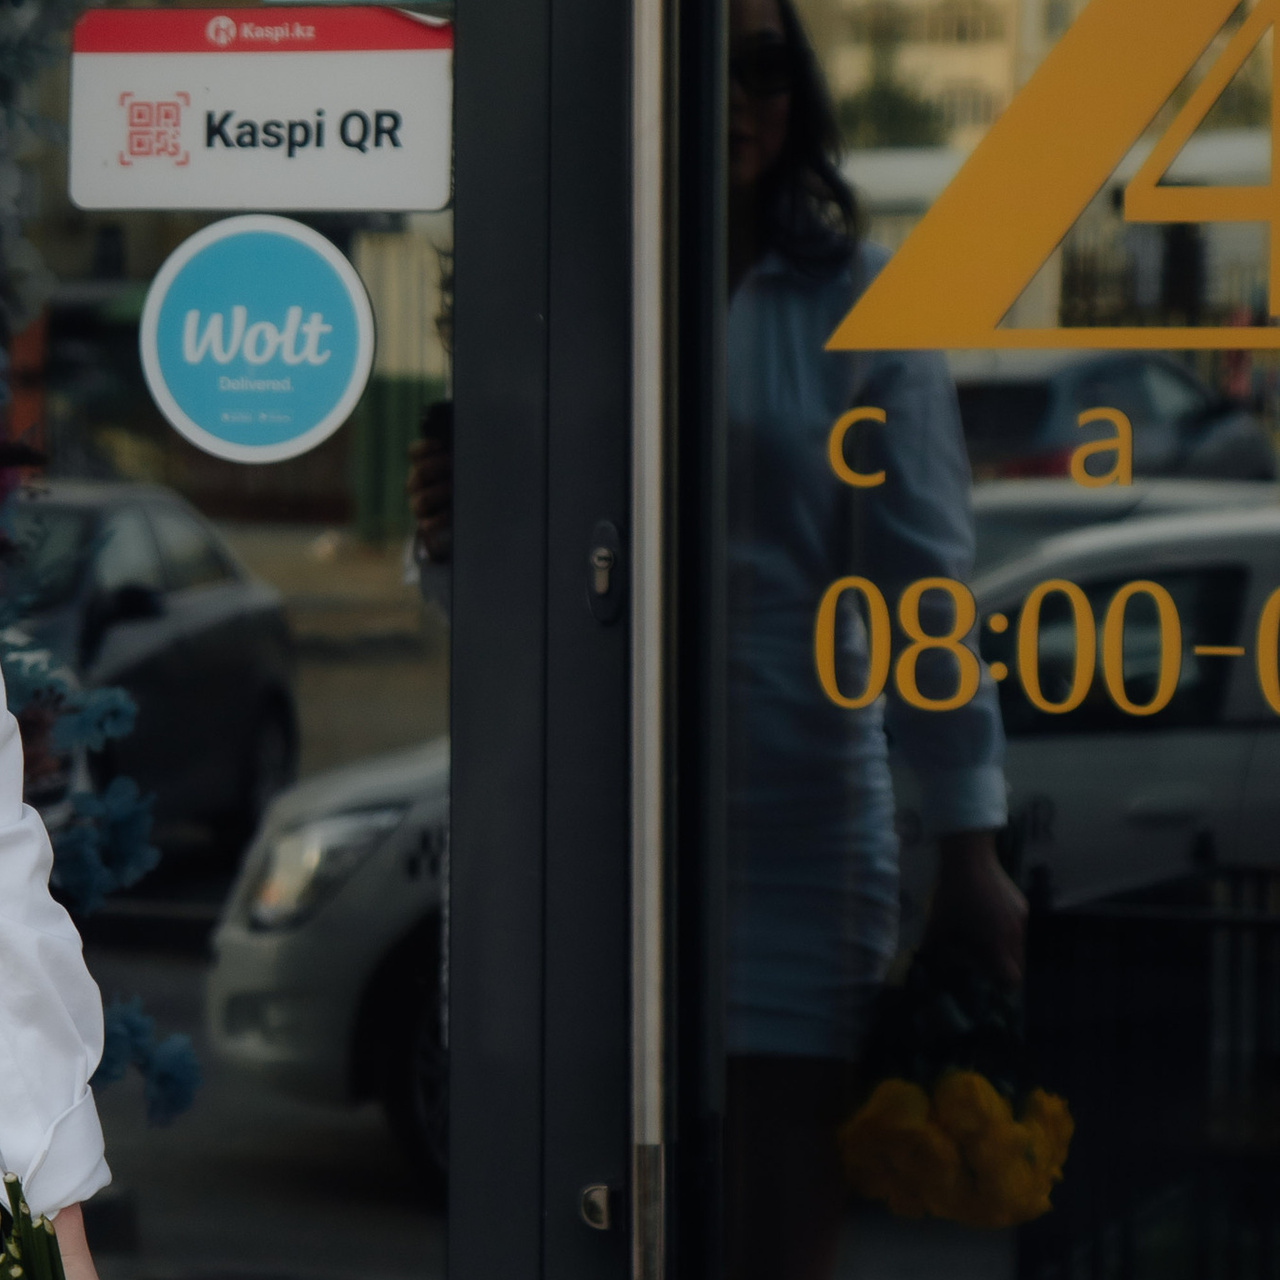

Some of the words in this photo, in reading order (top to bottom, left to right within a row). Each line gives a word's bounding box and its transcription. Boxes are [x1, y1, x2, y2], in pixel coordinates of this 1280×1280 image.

[240, 22, 315, 42] Kaspi.kz
[205, 110, 326, 158] Kaspi
[340, 110, 402, 152] QR
[182, 305, 332, 365] Wolt
